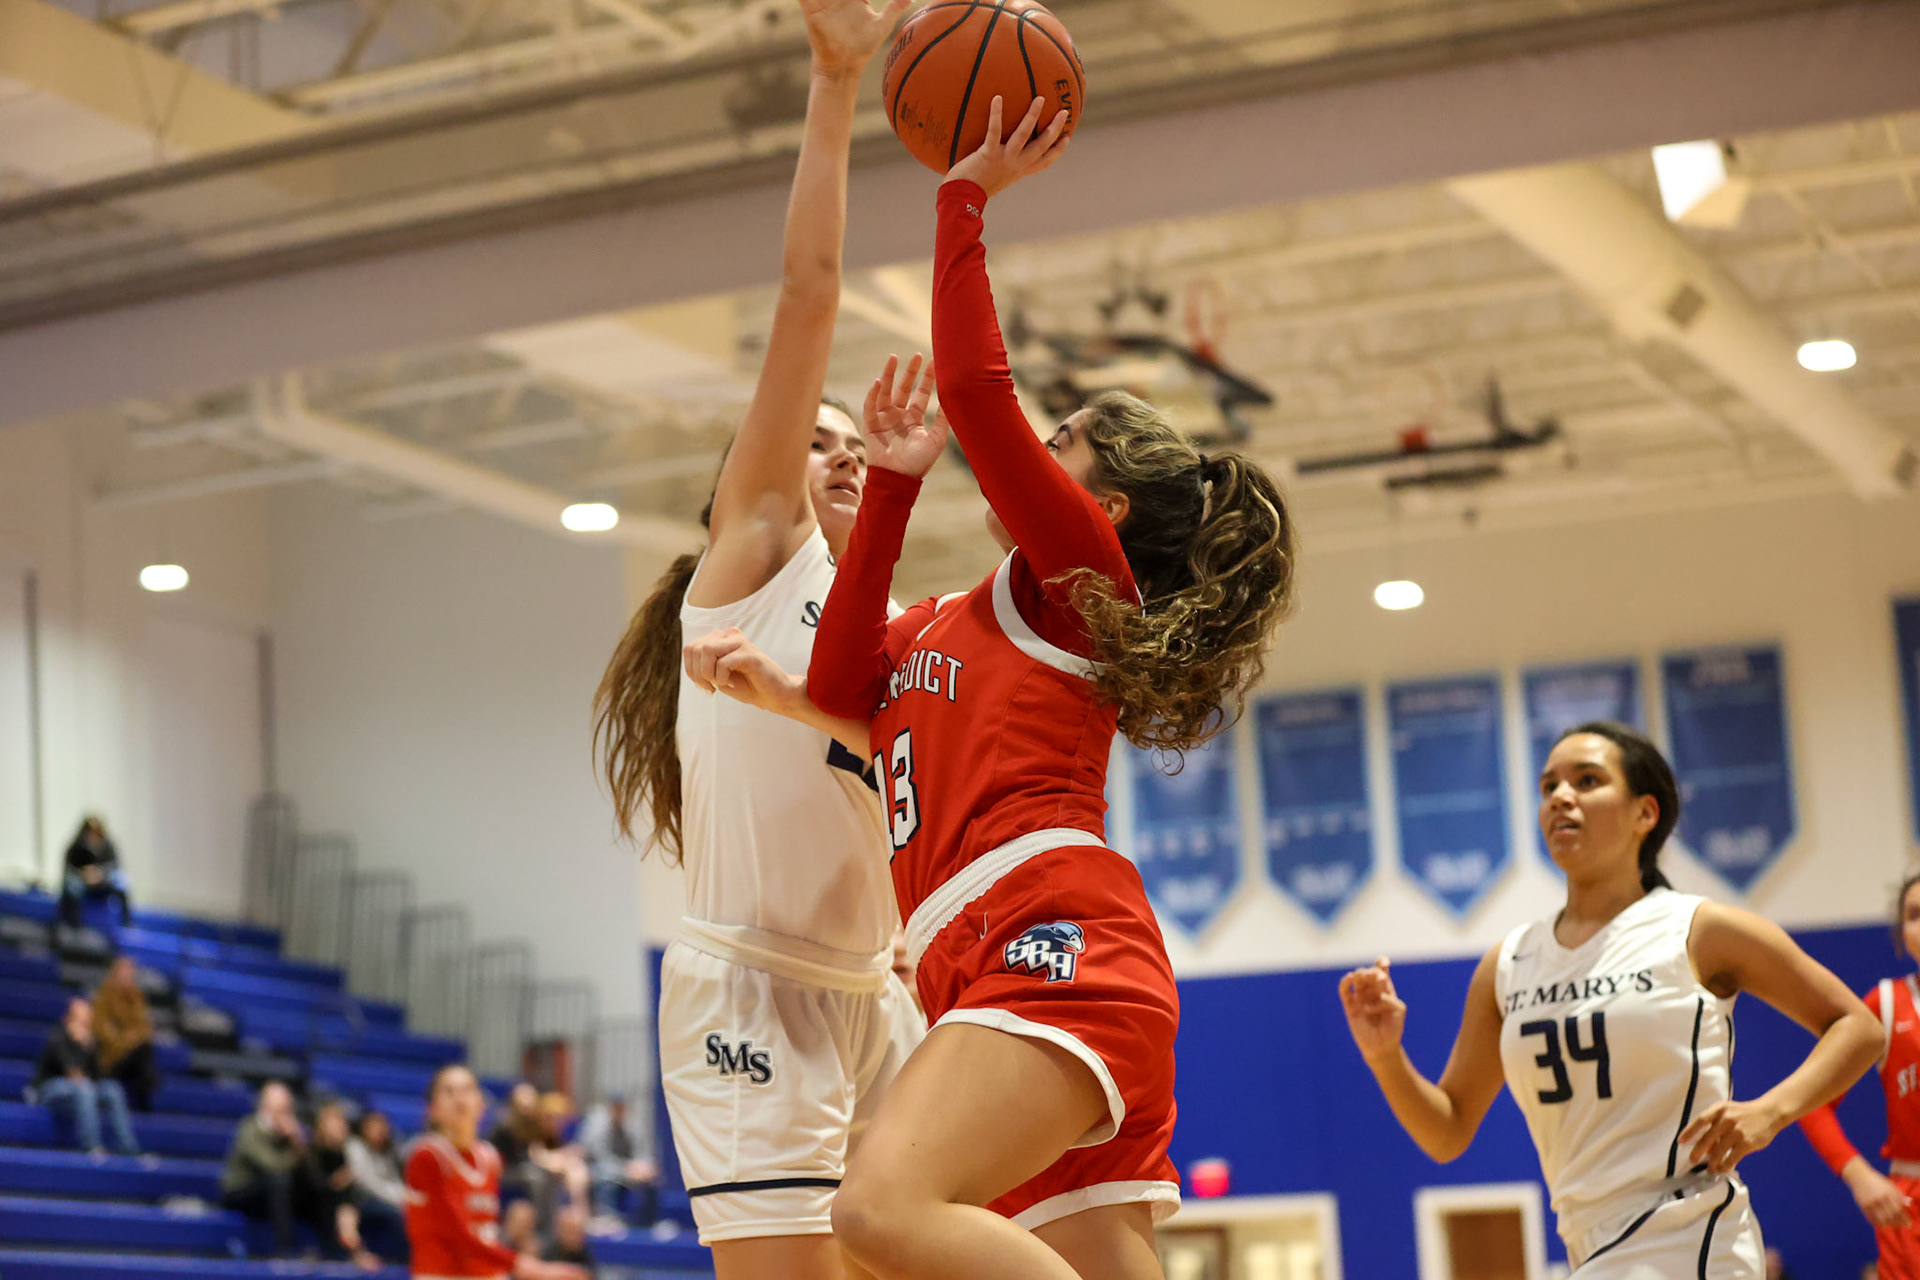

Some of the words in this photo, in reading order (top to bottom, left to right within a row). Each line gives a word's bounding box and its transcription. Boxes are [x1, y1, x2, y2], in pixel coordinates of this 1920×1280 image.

[872, 727, 921, 866] 13
[1004, 933, 1076, 982] SBA
[1505, 990, 1527, 1013] T.
[1532, 968, 1653, 1007] MARY'S
[706, 1032, 773, 1085] SMS
[1520, 1011, 1613, 1105] 34
